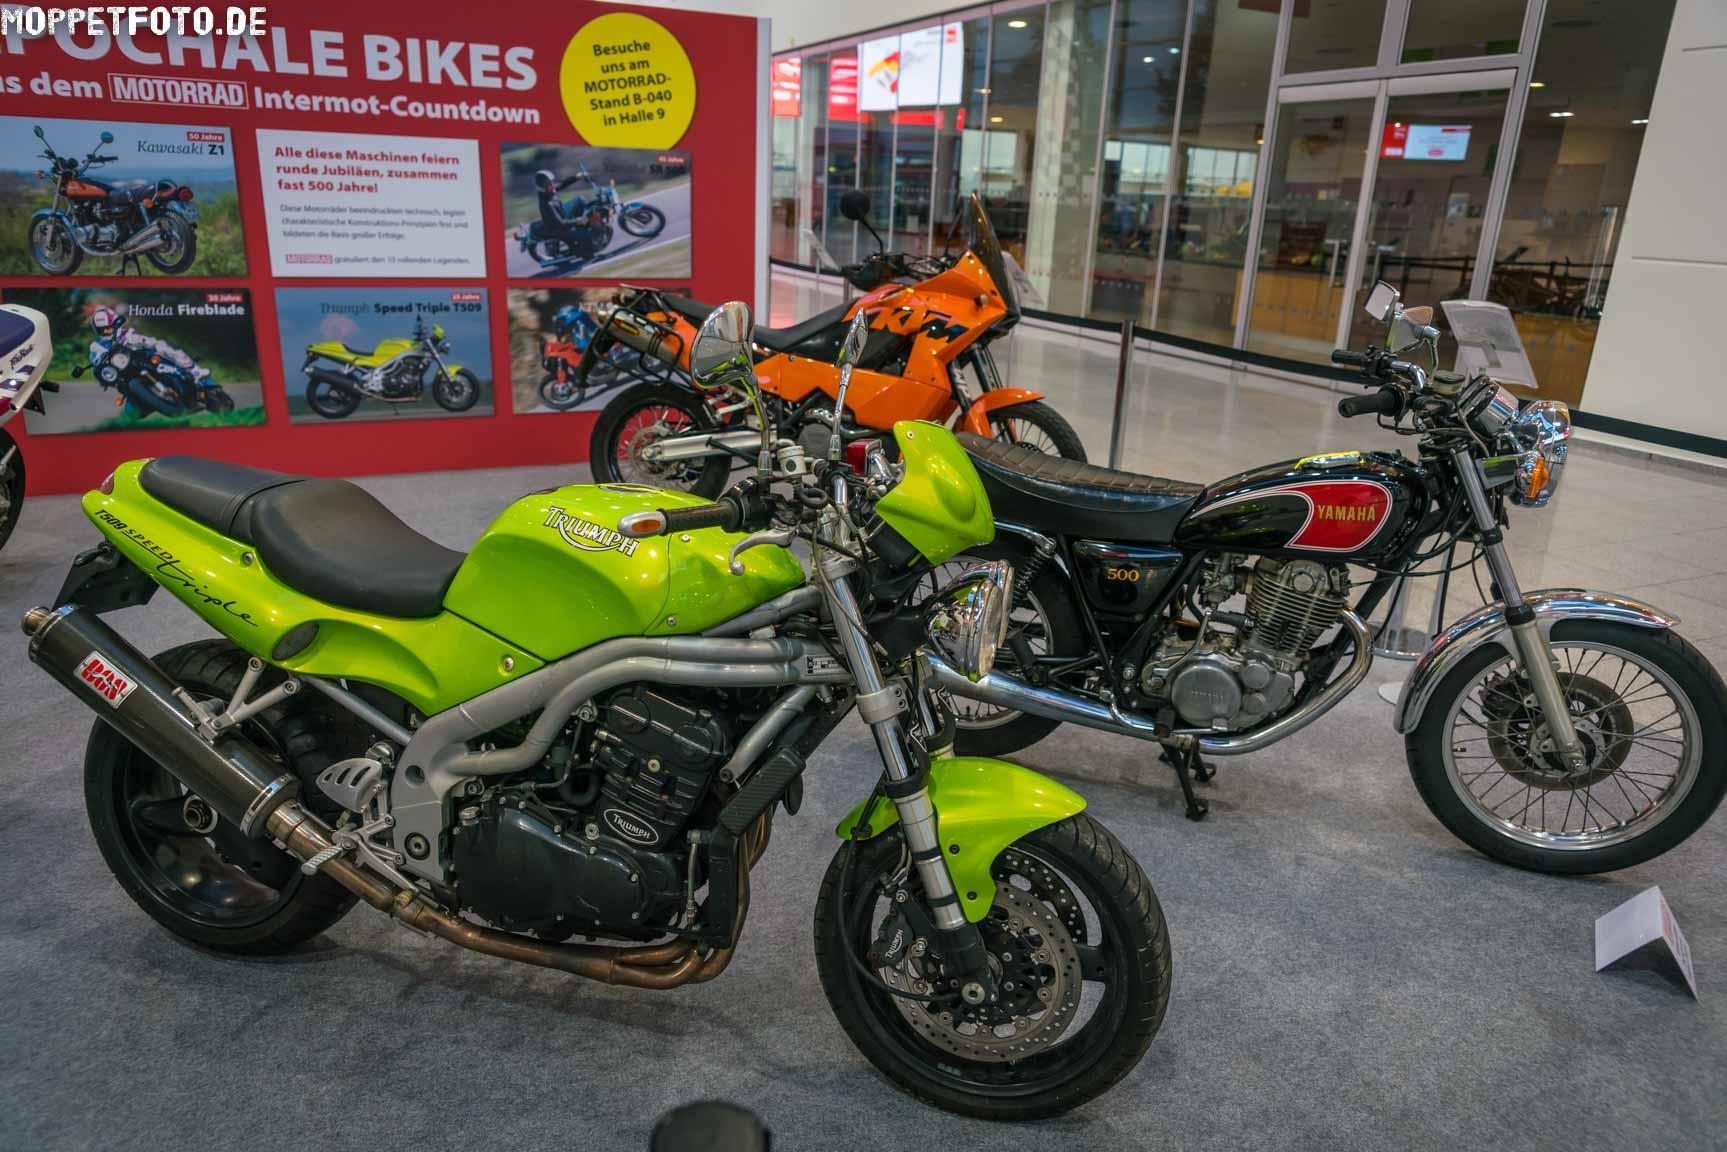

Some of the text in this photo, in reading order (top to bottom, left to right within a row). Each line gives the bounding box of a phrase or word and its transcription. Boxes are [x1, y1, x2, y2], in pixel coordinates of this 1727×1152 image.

[0, 4, 538, 91] POCHALE BIKES
[593, 40, 651, 56] Besuche
[601, 60, 650, 74] uns am
[584, 73, 672, 93] MOTORRAD-
[0, 71, 540, 124] s dem MOTORRAD Intermot-Countdown
[590, 90, 672, 110] Stand B-040
[603, 108, 665, 126] in Halle 9
[201, 133, 223, 141] Jahre
[137, 140, 225, 155] Kawasaki Z1
[275, 147, 460, 165] Alle diese Maschinen feiern
[276, 164, 458, 180] runde Jubiläen, zusammen
[278, 179, 378, 193] fast 500 Jahre!
[129, 304, 246, 316] Honda Fireblade
[320, 302, 482, 315] Triumph Speed Triple T509
[1318, 504, 1377, 522] YAMAHA
[95, 509, 174, 560] T509 SPEED
[543, 506, 641, 557] TRIUMPH
[1107, 568, 1140, 582] 500
[156, 559, 259, 627] triple
[612, 812, 651, 840] TRIUMPH
